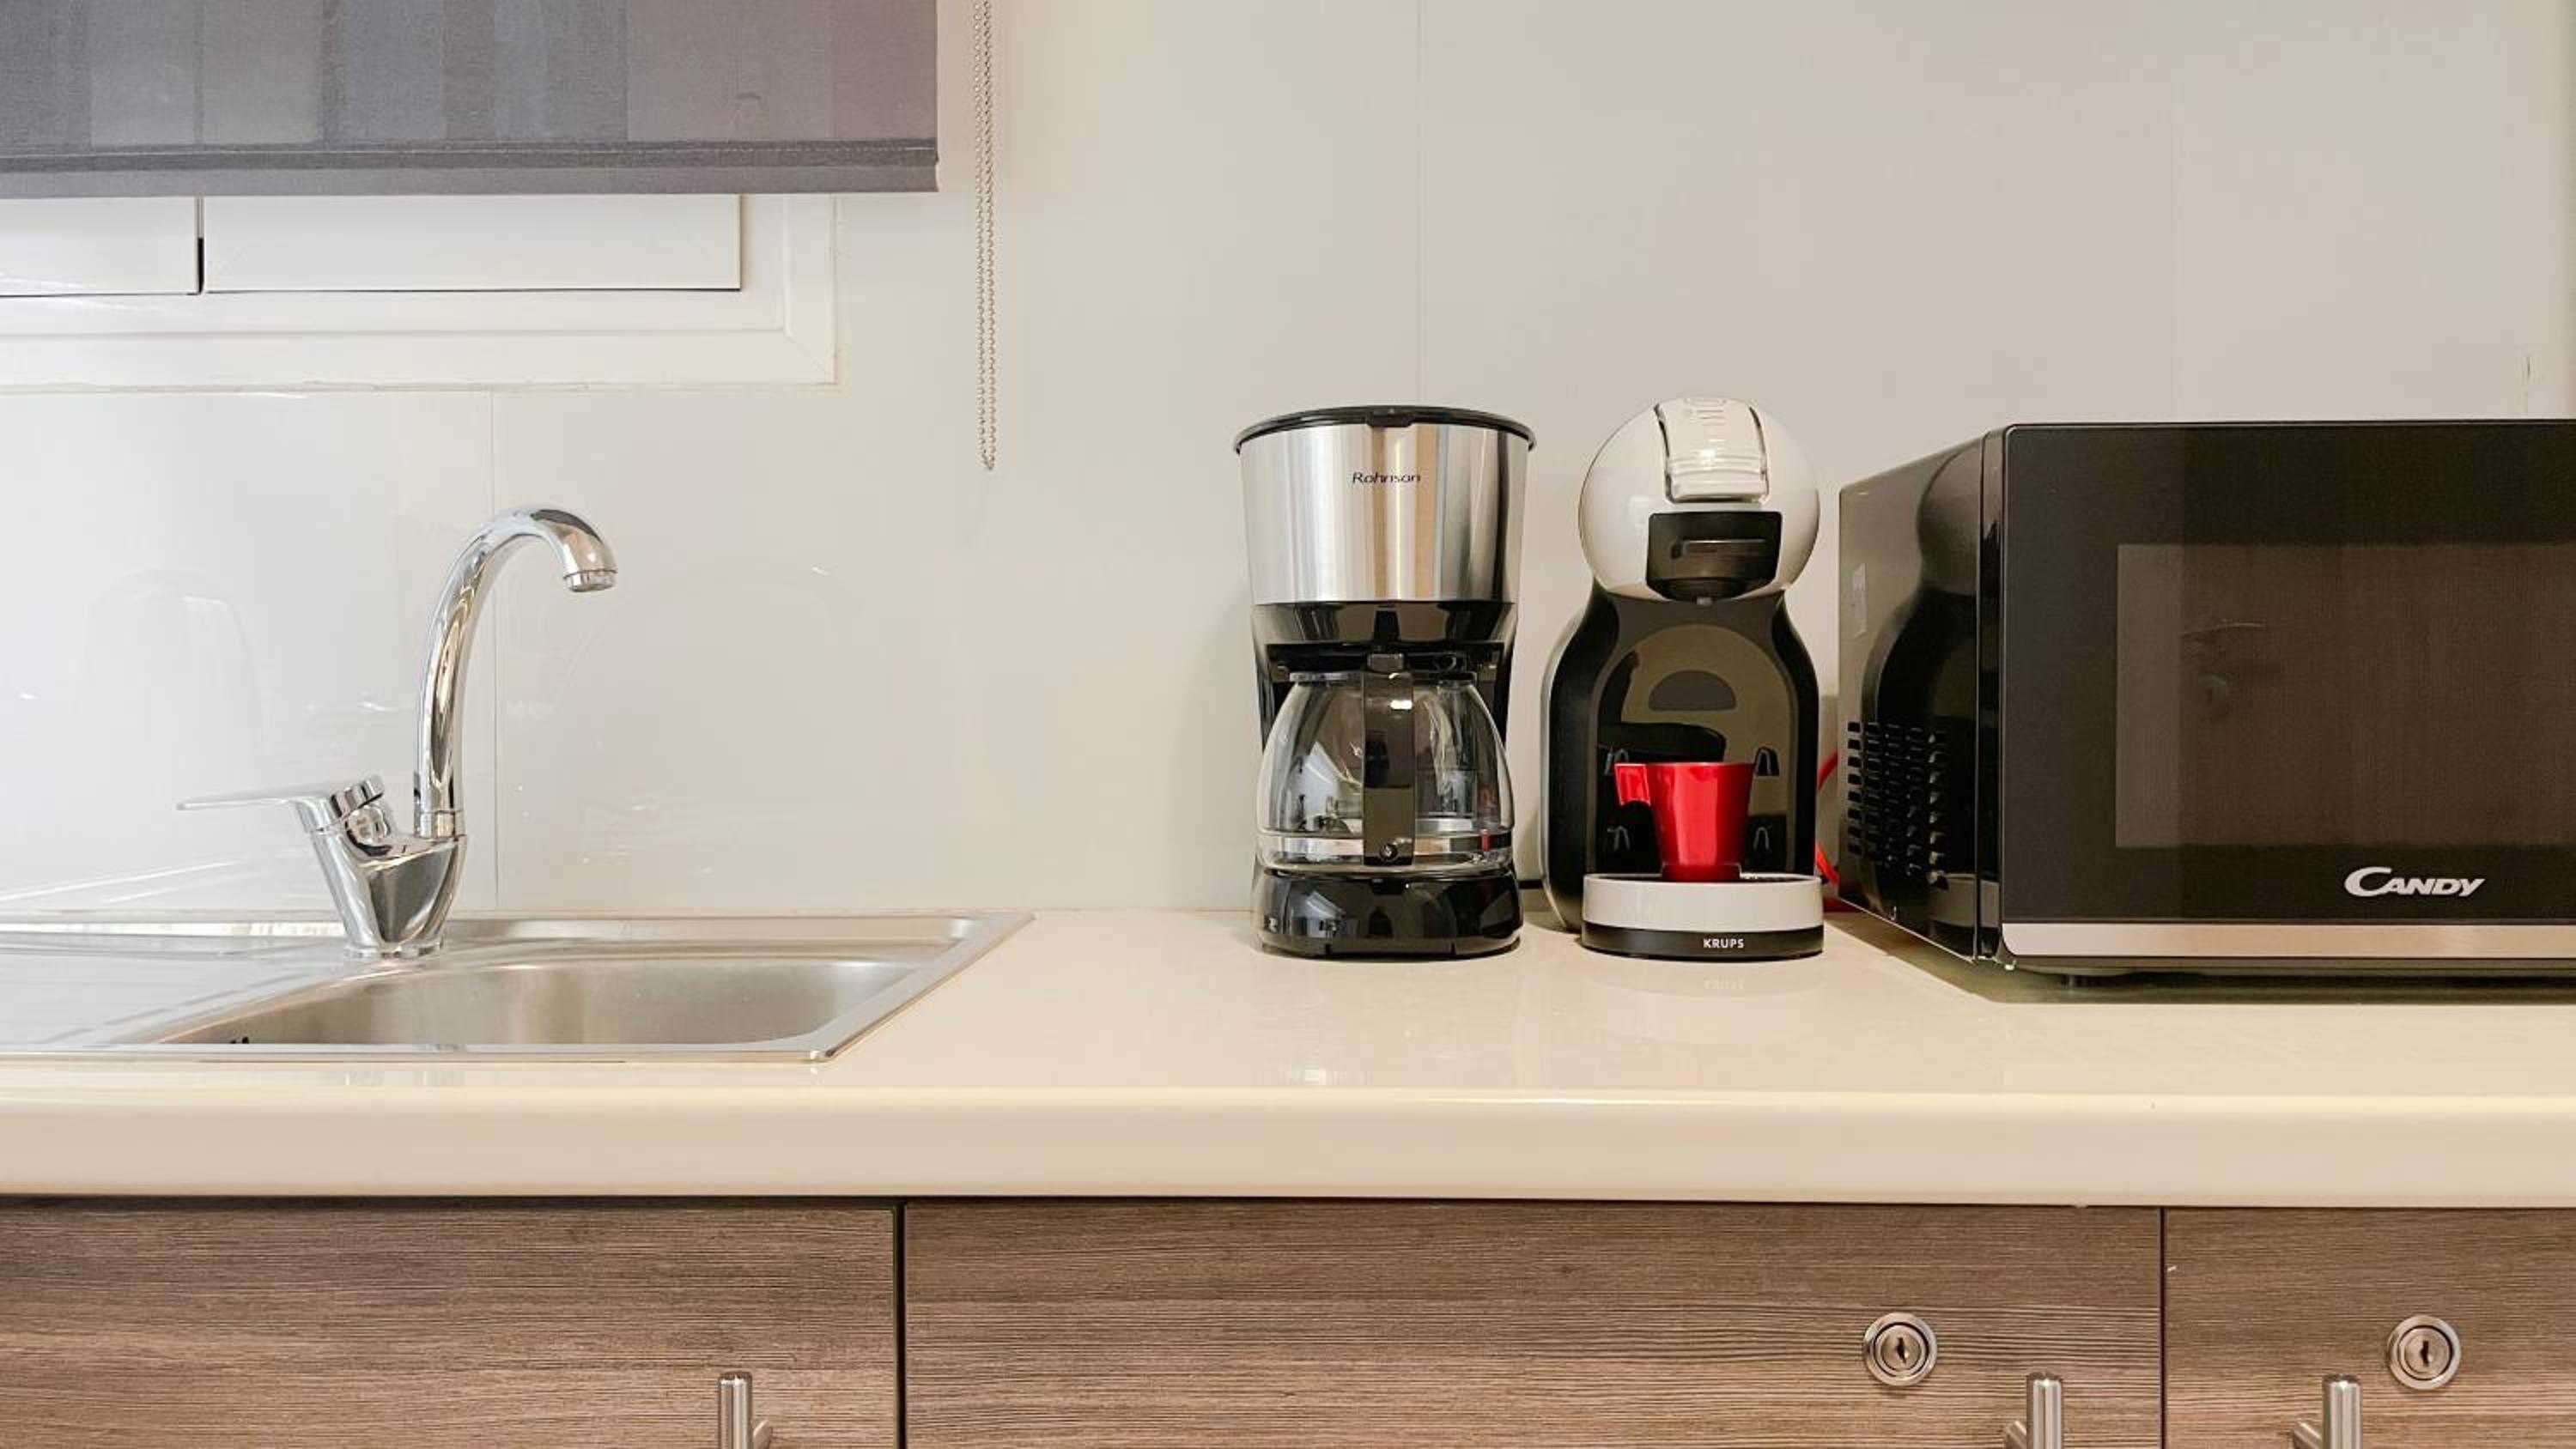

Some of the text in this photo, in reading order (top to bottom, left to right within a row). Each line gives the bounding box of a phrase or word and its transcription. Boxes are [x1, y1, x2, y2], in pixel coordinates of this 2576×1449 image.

[1352, 471, 1422, 484] Rohnson
[2343, 865, 2487, 898] CANDY
[1703, 937, 1745, 949] KRUPS
